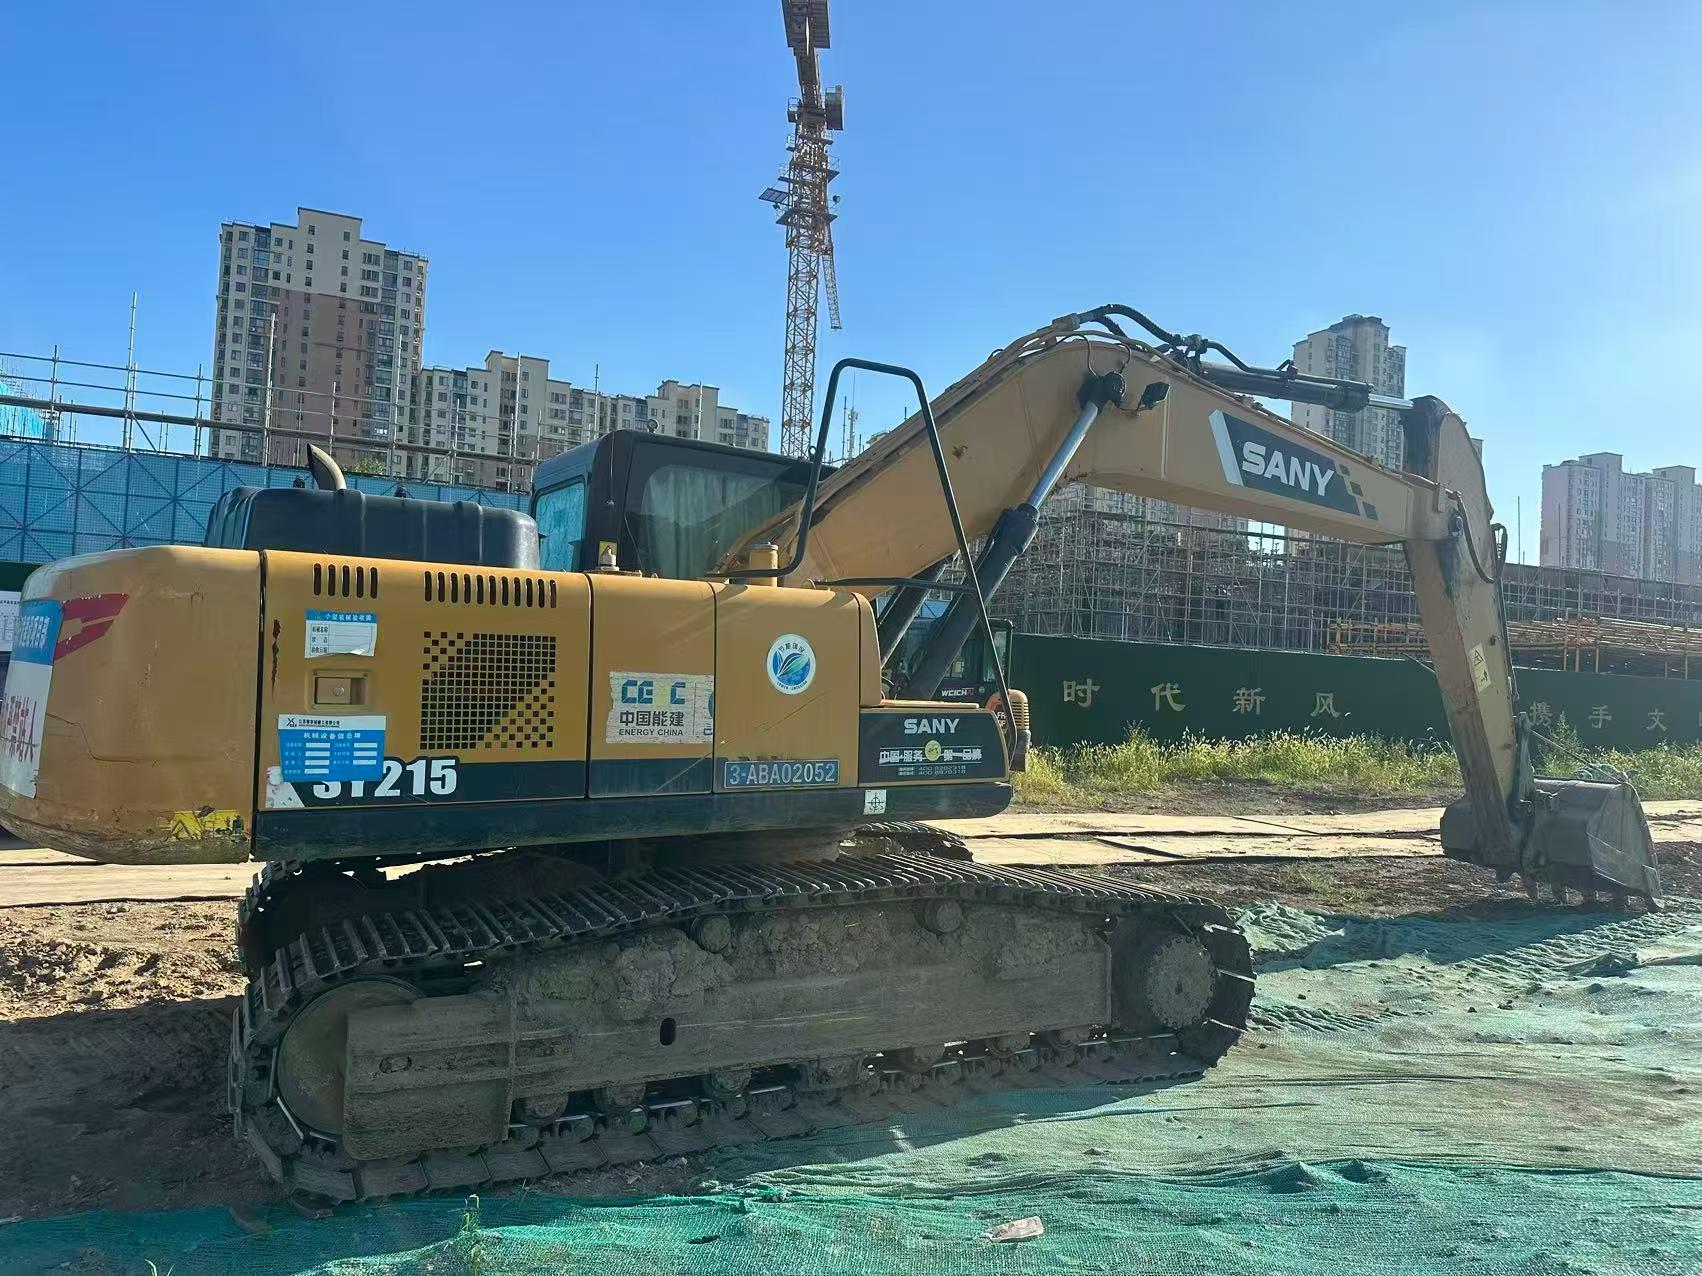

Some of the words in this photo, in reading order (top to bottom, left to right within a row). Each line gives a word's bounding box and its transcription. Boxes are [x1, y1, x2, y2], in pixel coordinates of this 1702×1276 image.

[1242, 441, 1335, 497] SANY
[1063, 678, 1340, 718] 时代新风
[620, 711, 684, 727] 中国能建
[904, 718, 959, 734] SANY
[303, 732, 361, 740] 机械设备信息牌
[729, 763, 835, 785] 3-ABA02052
